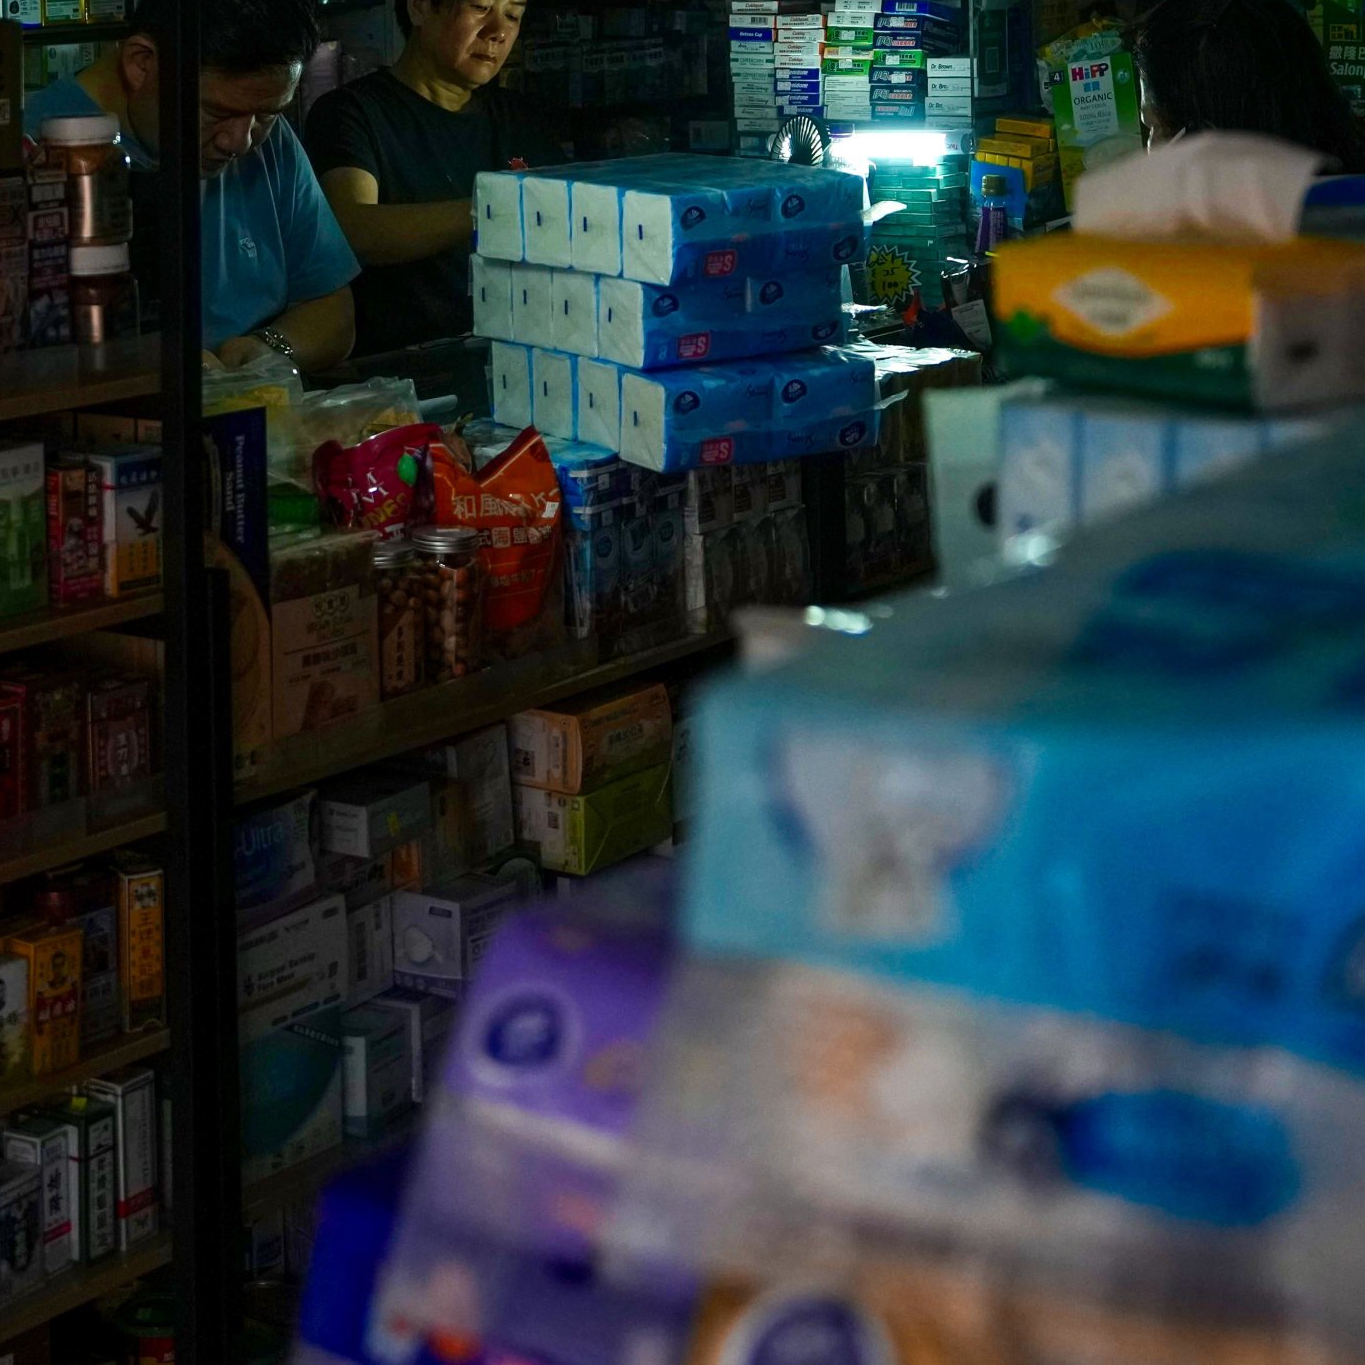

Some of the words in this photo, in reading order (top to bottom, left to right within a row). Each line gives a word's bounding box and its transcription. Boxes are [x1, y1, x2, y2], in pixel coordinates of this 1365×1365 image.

[1071, 62, 1109, 82] HiPP
[1073, 91, 1114, 106] ORGANIC
[234, 434, 246, 490] Peanut
[234, 492, 246, 544] Butter
